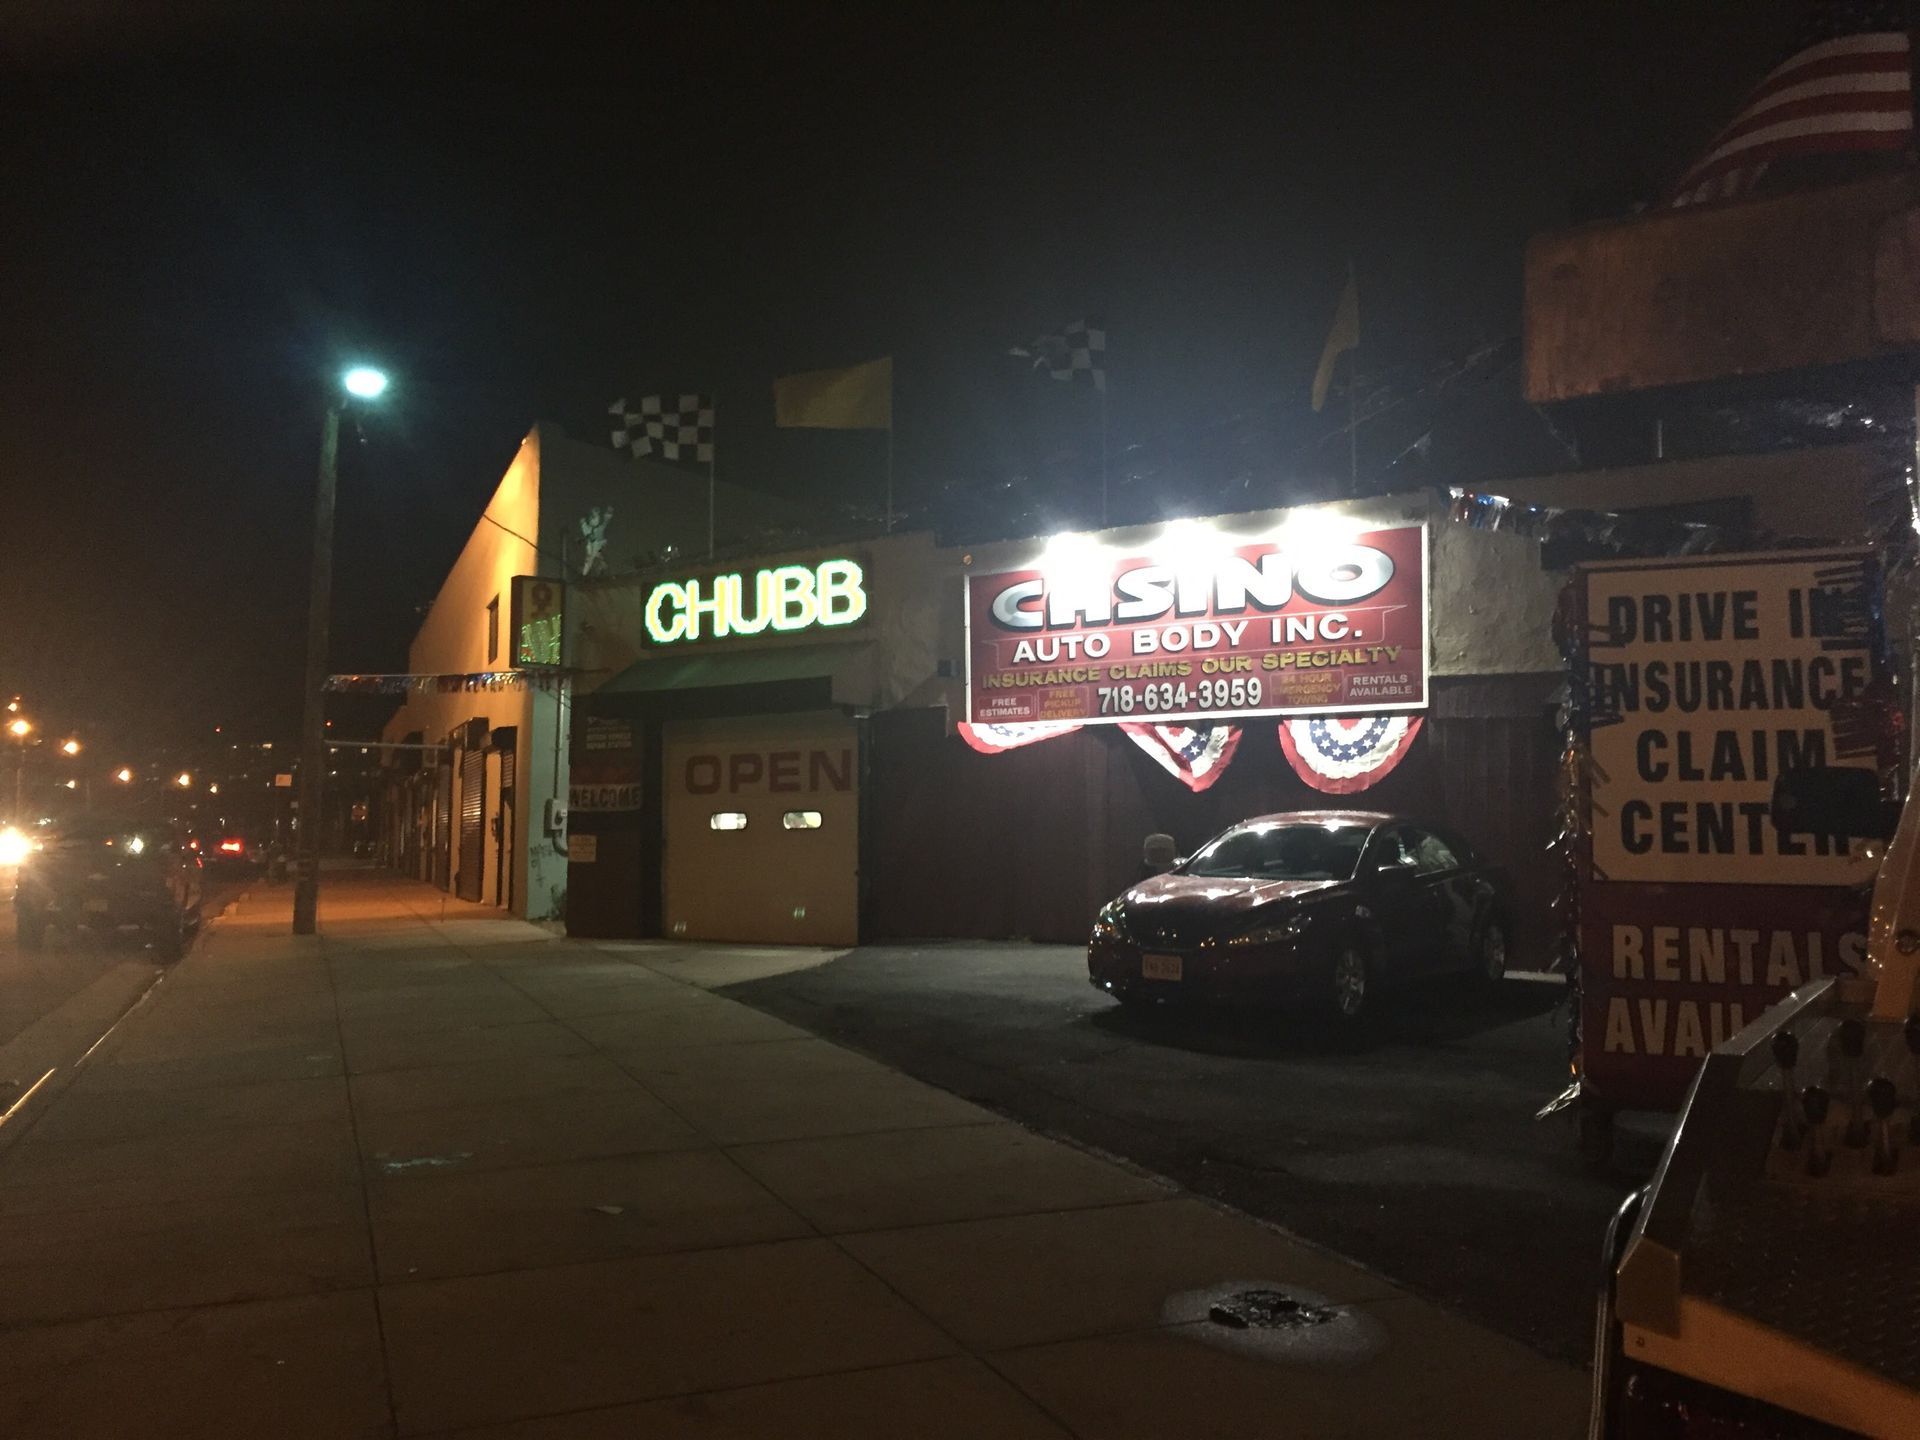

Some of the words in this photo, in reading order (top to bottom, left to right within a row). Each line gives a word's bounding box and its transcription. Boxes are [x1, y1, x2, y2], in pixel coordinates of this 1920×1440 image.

[645, 559, 867, 643] CHUBB
[1608, 590, 1760, 645] DRIVE
[1013, 633, 1111, 663] AUTO
[1133, 621, 1250, 653] BODY
[1272, 614, 1363, 643] INC.
[982, 668, 1100, 688] INSURANCE
[1110, 661, 1192, 681] CLAIMS
[1202, 656, 1252, 674] OUR
[1263, 645, 1402, 670] SPECIALTY
[1353, 674, 1408, 686] RENTALS
[992, 697, 1017, 706] FREE
[1098, 676, 1262, 713] 718-634-3959
[1350, 685, 1412, 697] AVAILABLE
[979, 706, 1031, 717] ESTIMATES
[685, 749, 852, 795] OPEN
